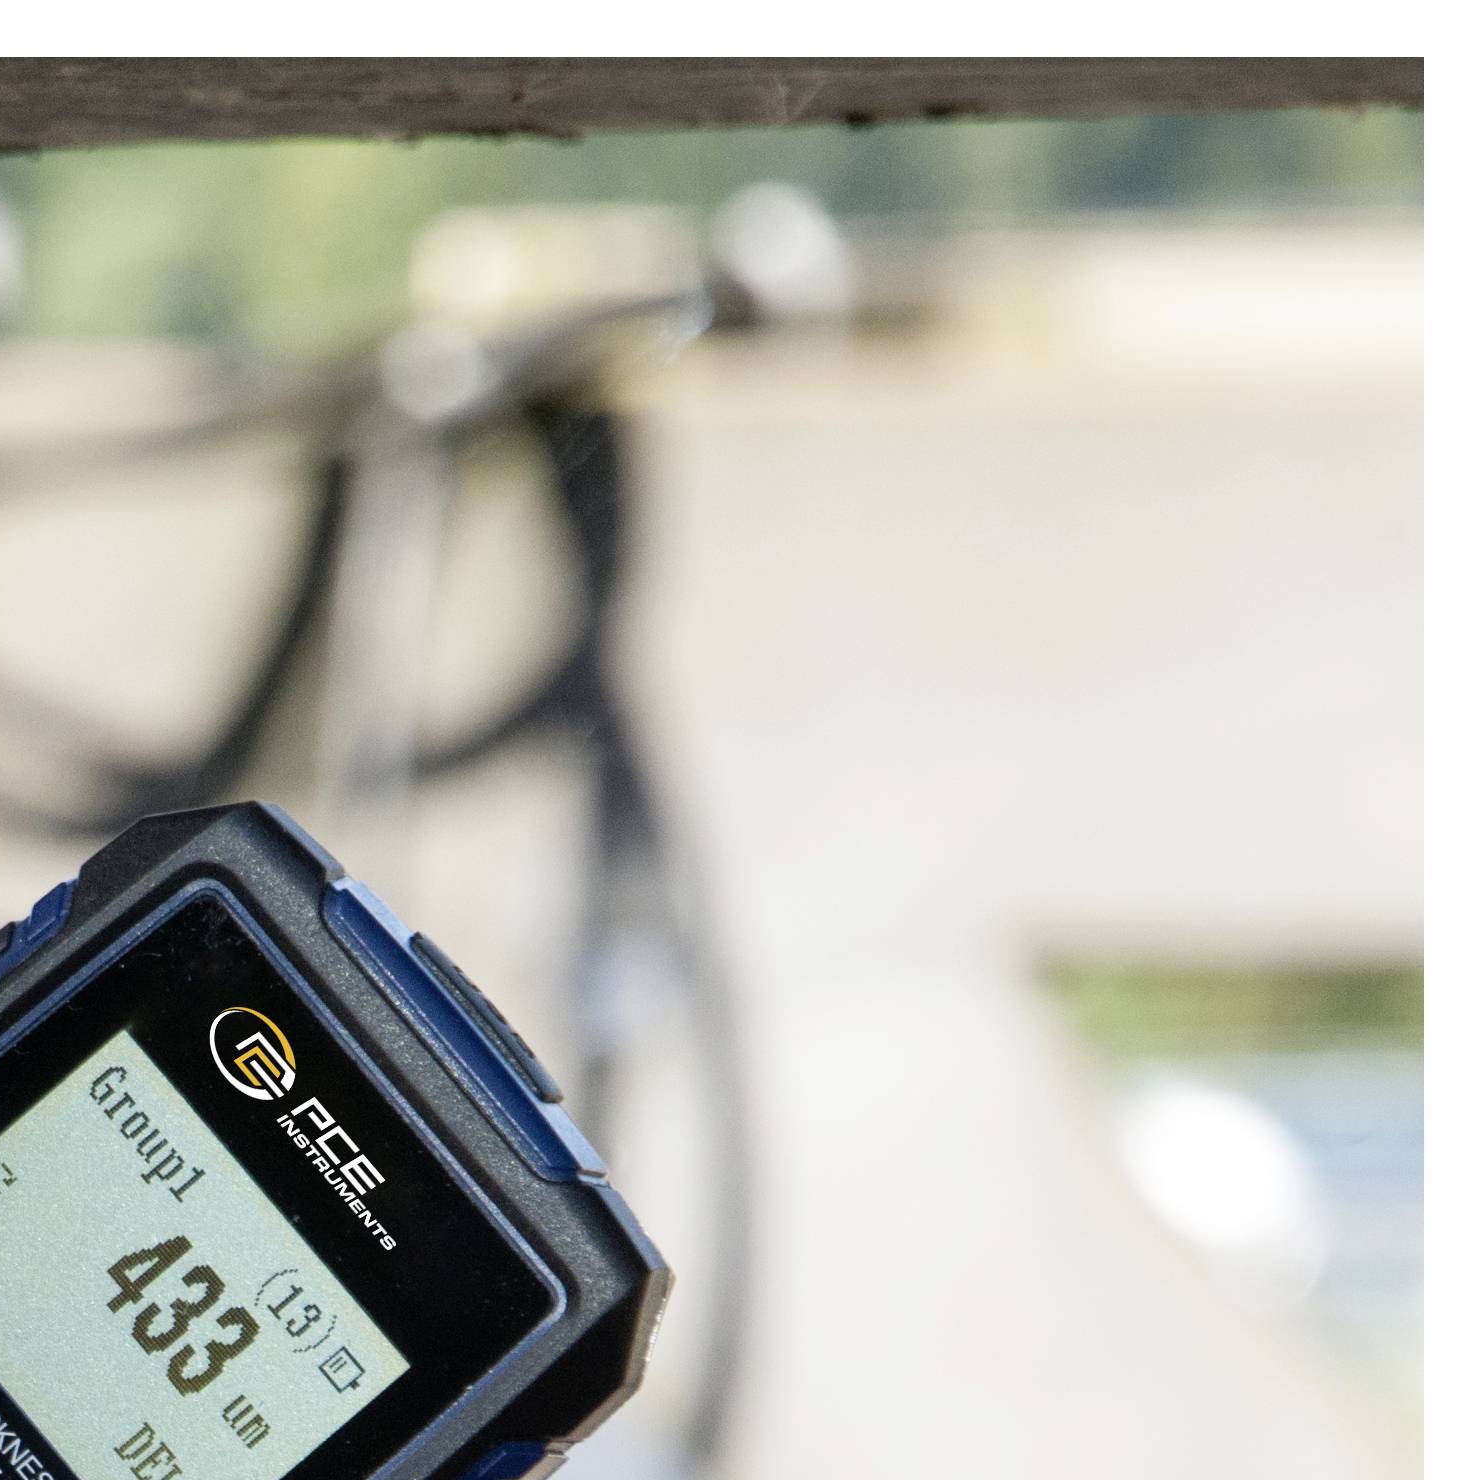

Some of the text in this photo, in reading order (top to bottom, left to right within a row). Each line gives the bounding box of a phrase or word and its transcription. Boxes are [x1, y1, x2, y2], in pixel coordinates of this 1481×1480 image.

[91, 1065, 206, 1202] Group1
[277, 1114, 396, 1250] INSTRUMENTS
[291, 1097, 385, 1194] PCE
[107, 1235, 260, 1395] 433
[255, 1268, 337, 1352] (13)
